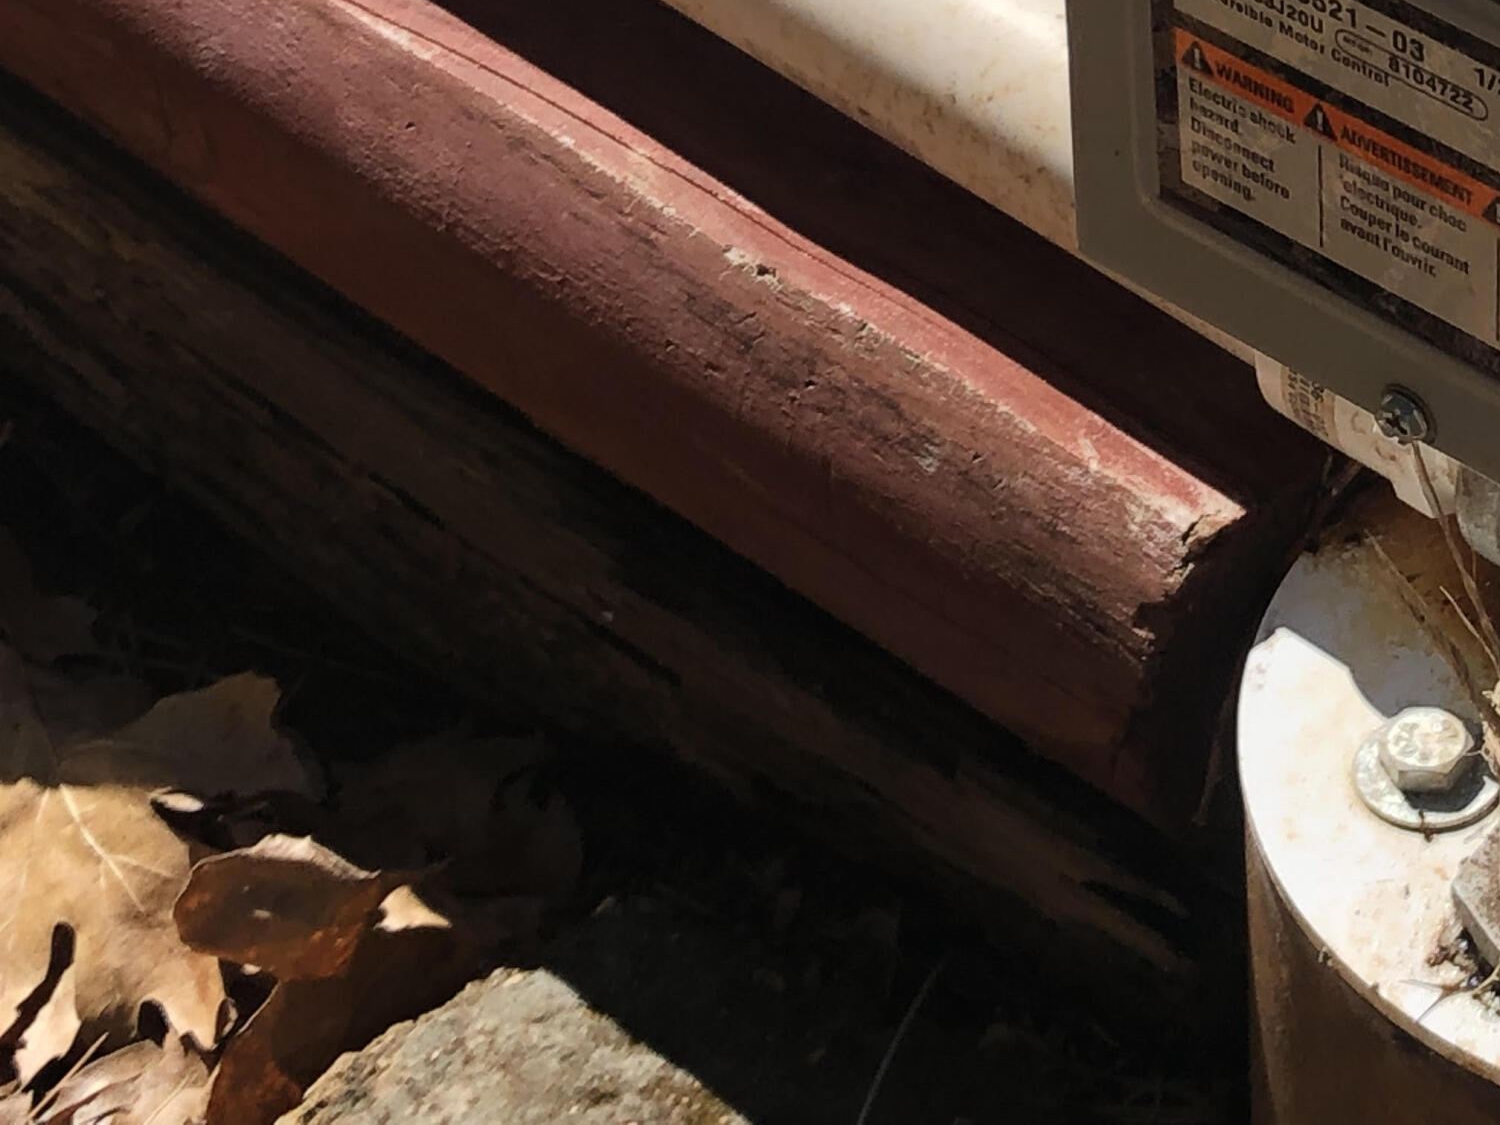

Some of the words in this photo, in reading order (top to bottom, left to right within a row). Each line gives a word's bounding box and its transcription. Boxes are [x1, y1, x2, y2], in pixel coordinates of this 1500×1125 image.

[1279, 18, 1325, 54] Motor
[1331, 48, 1390, 87] Control
[1188, 78, 1247, 119] Electric
[1250, 110, 1297, 145] shock
[1216, 63, 1295, 114] WARNING
[1388, 56, 1475, 113] 8104722
[1190, 116, 1276, 173] Disconnect
[1191, 139, 1239, 173] power
[1242, 162, 1291, 200] before
[1192, 160, 1255, 202] opening.
[1392, 181, 1427, 212] pour
[1429, 203, 1468, 233] choc
[1340, 218, 1381, 247] avant
[1340, 195, 1393, 234] Couper
[1395, 223, 1410, 244] le
[1412, 233, 1470, 276] courant
